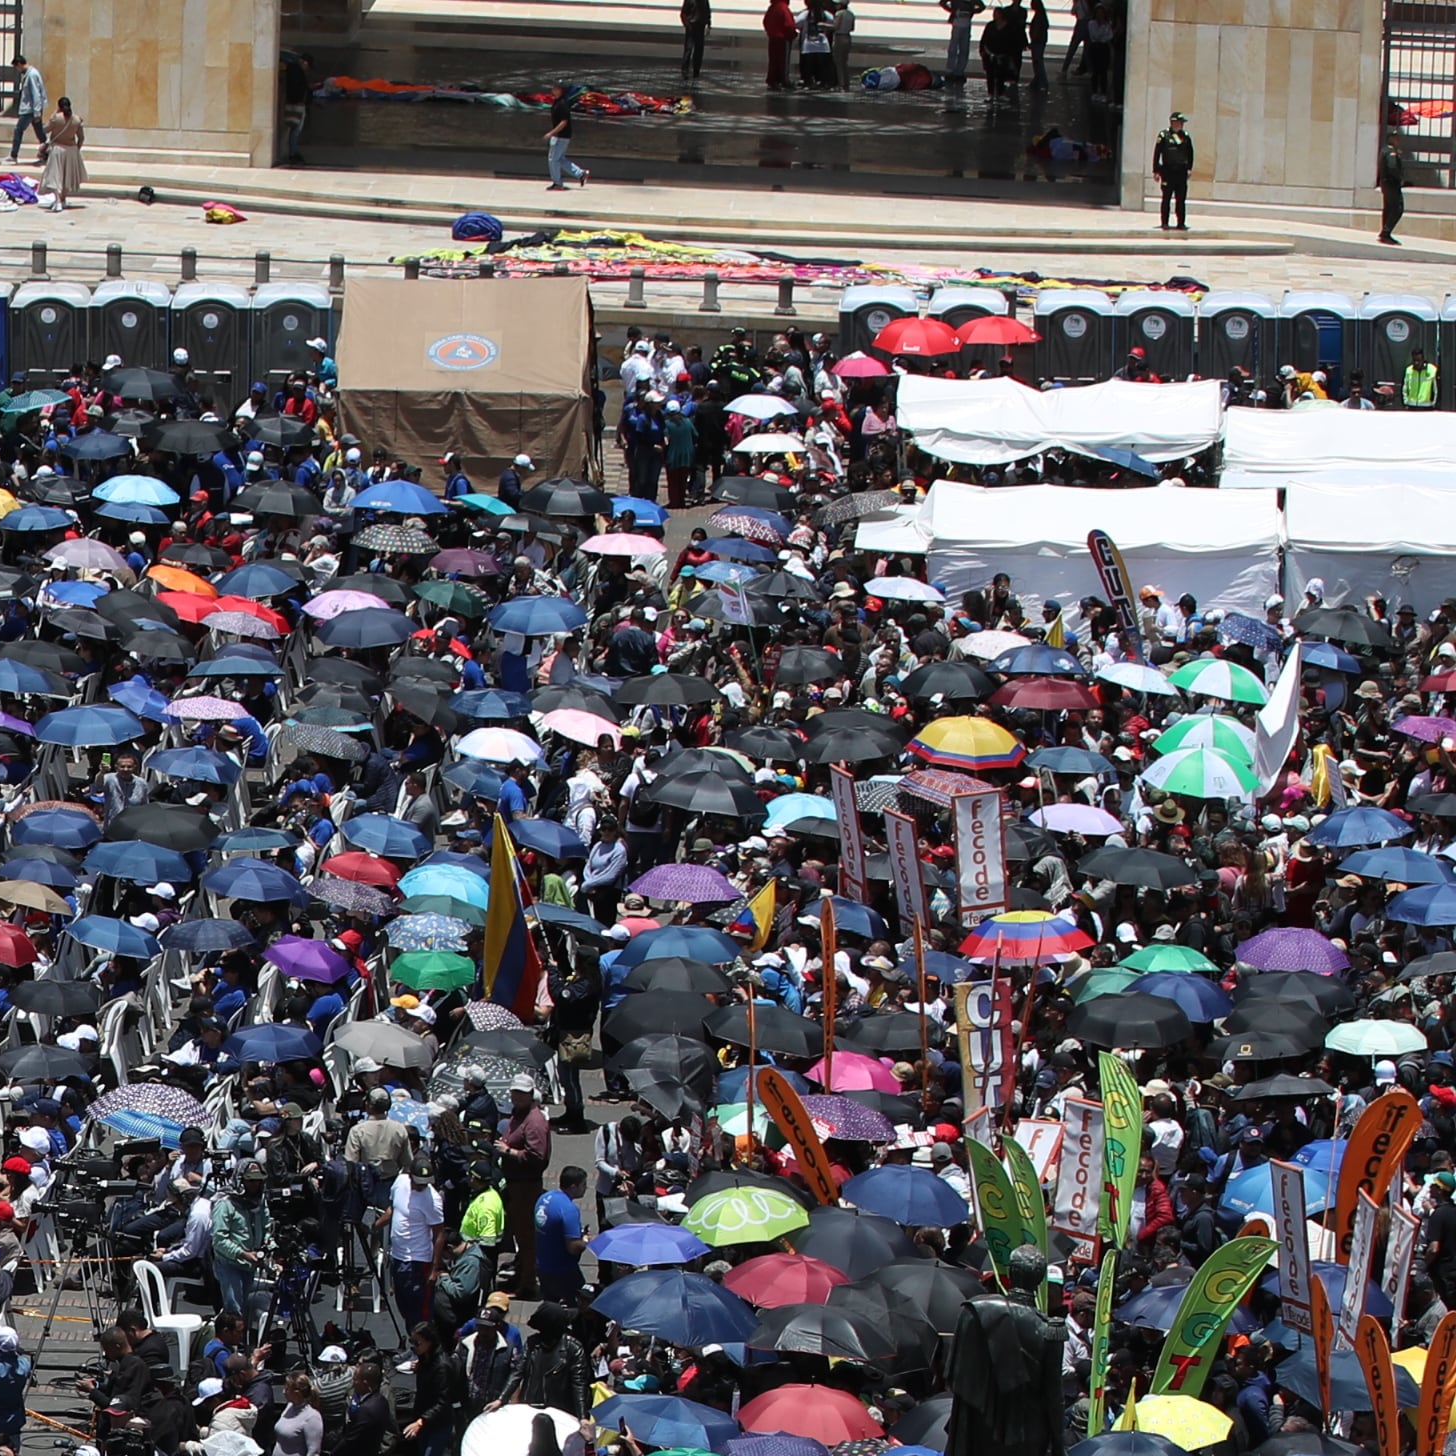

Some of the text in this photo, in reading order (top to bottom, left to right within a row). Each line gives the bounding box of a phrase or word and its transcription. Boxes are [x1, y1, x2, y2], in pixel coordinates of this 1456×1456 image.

[1094, 536, 1135, 629] CUT
[970, 798, 991, 902] fecode
[966, 984, 1003, 1117] CUT
[1068, 1109, 1094, 1227] fecode
[1104, 1091, 1129, 1222] CGT
[1280, 1174, 1300, 1296] fecode
[1168, 1268, 1249, 1391] CGT
